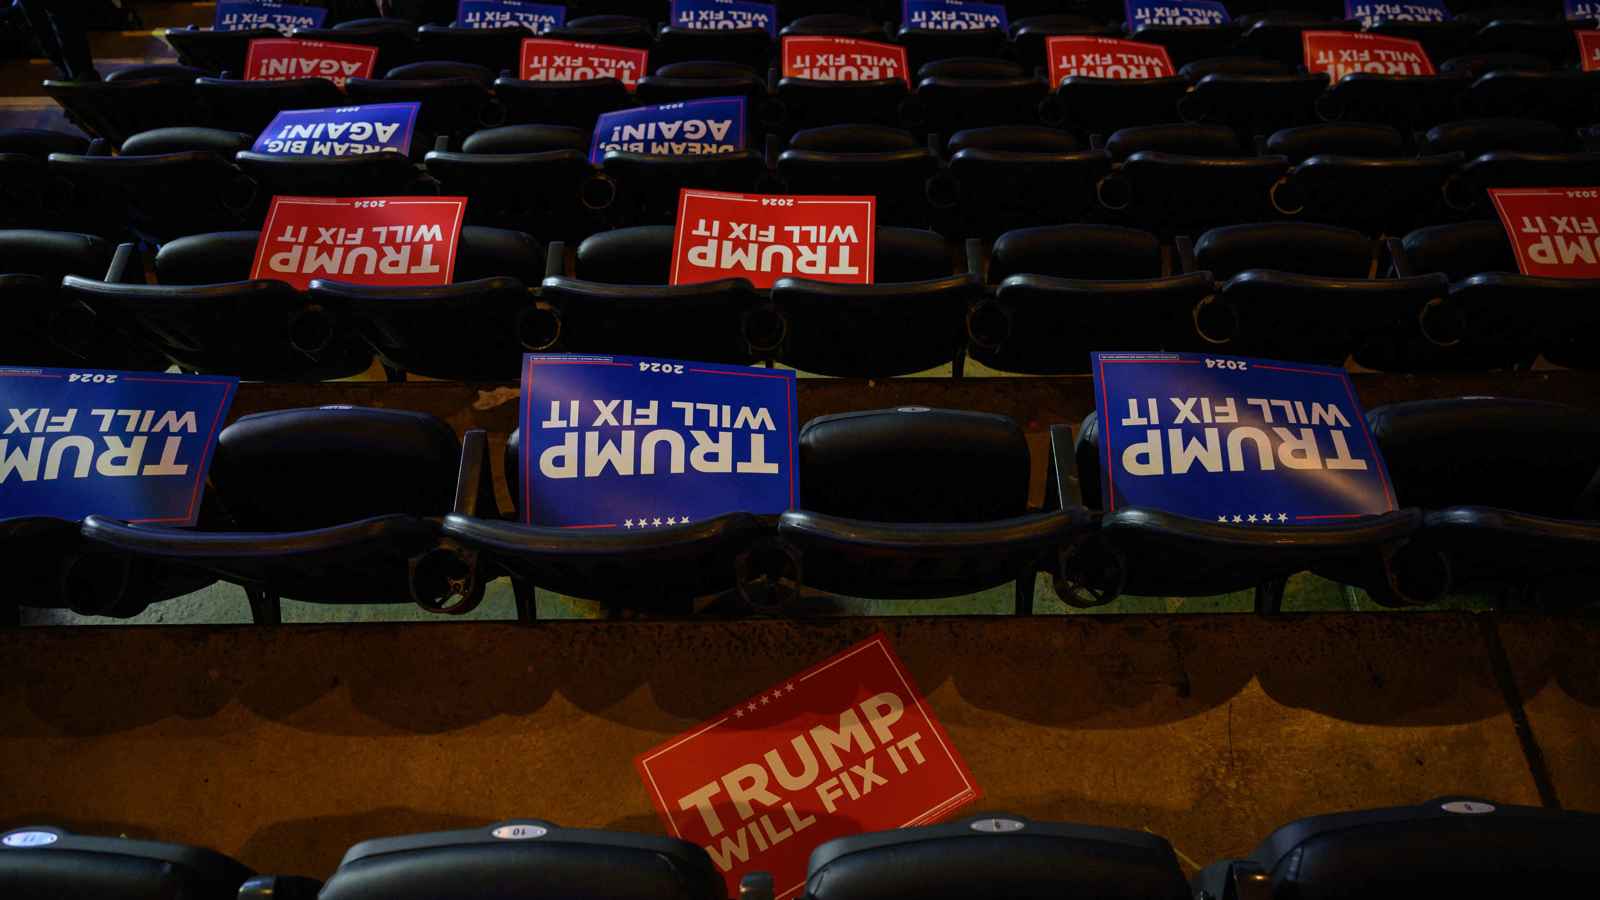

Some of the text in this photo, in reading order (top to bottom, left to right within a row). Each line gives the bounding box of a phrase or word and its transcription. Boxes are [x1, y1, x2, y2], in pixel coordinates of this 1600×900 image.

[222, 13, 314, 25] WILL FIX IT
[465, 11, 556, 24] WILL FIX IT
[679, 10, 769, 22] WILL FIX IT
[911, 10, 1001, 24] WILL FIX IT
[530, 55, 636, 70] WILL FIX IT
[792, 54, 899, 68] WILL FIX IT
[1059, 53, 1163, 69] WILL FIX IT
[1316, 49, 1422, 64] WILL FIX IT
[259, 57, 364, 76] AGAIN!
[277, 122, 400, 143] AGAIN!
[611, 119, 732, 142] AGAIN!
[761, 198, 794, 206] 2024
[1566, 190, 1598, 199] 2024
[354, 200, 386, 208] 2024
[691, 218, 859, 244] WILL FIX IT
[1521, 216, 1598, 234] FIX IT
[277, 224, 444, 245] WILL FIX IT
[269, 244, 440, 275] TRUMP
[688, 238, 859, 275] TRUMP
[639, 361, 684, 375] 2024
[1204, 358, 1248, 371] 2024
[68, 373, 118, 384] 2024
[3, 408, 198, 434] WILL FIX
[542, 400, 776, 431] WILL FIX IT
[1121, 397, 1352, 428] WILL FIX IT
[0, 435, 189, 484] TRUM
[539, 428, 779, 479] TRUMP
[1121, 426, 1368, 476] TRUMP
[678, 691, 905, 838] TRUMP
[704, 801, 817, 873] WILL
[815, 756, 889, 815] FIX
[886, 732, 927, 775] IT
